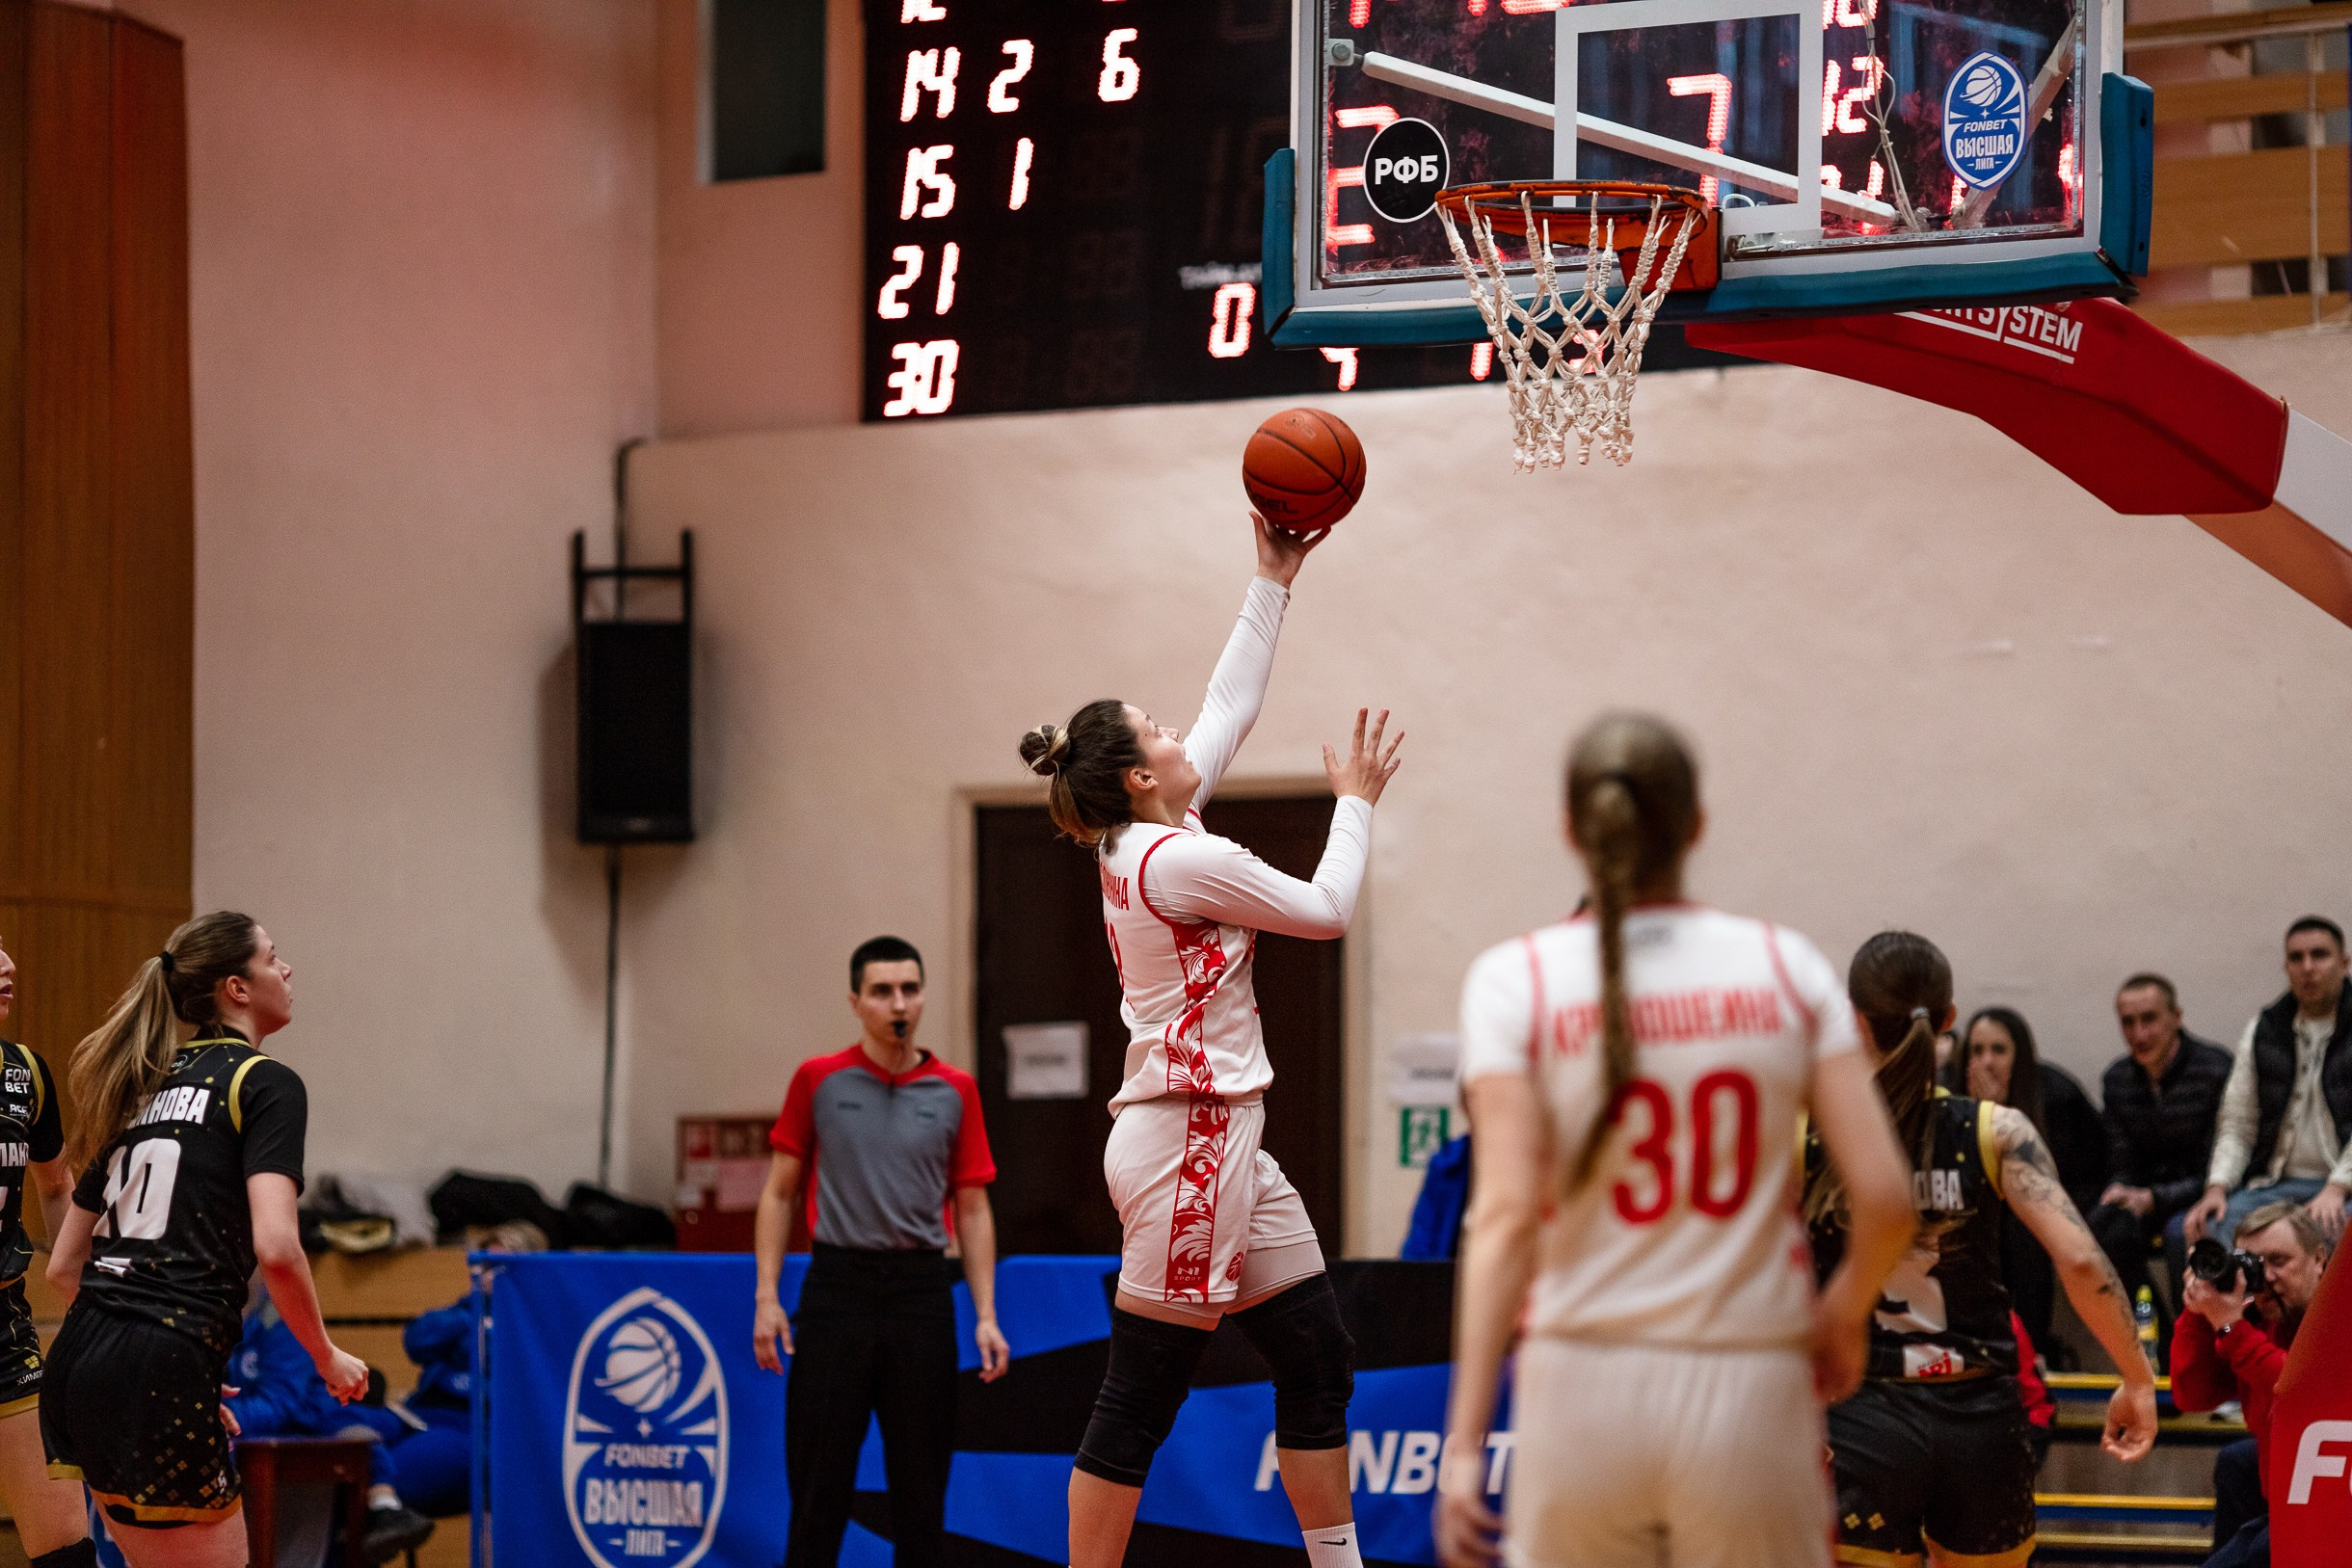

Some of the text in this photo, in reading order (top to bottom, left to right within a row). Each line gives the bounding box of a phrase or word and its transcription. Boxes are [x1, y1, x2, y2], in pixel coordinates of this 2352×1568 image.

[900, 29, 1140, 122] 14 2 6
[1822, 56, 1884, 136] 12
[1956, 134, 2014, 159] ВЫСШАЯ
[1964, 119, 2008, 133] FONBET
[899, 137, 1034, 220] 15 1
[1375, 155, 1439, 185] РФБ
[1975, 157, 1994, 171] ЛИГА
[877, 242, 960, 319] 21
[1209, 283, 1256, 358] 0
[883, 339, 960, 416] 30
[5, 1069, 31, 1081] FON
[5, 1081, 30, 1094] BET
[126, 1085, 211, 1127] НОВА
[1613, 1072, 1758, 1225] 30
[603, 1443, 691, 1470] FONBET
[1254, 1430, 1515, 1495] FNBT
[2286, 1419, 2352, 1505] F
[584, 1477, 704, 1528] ВЫСШАЯ
